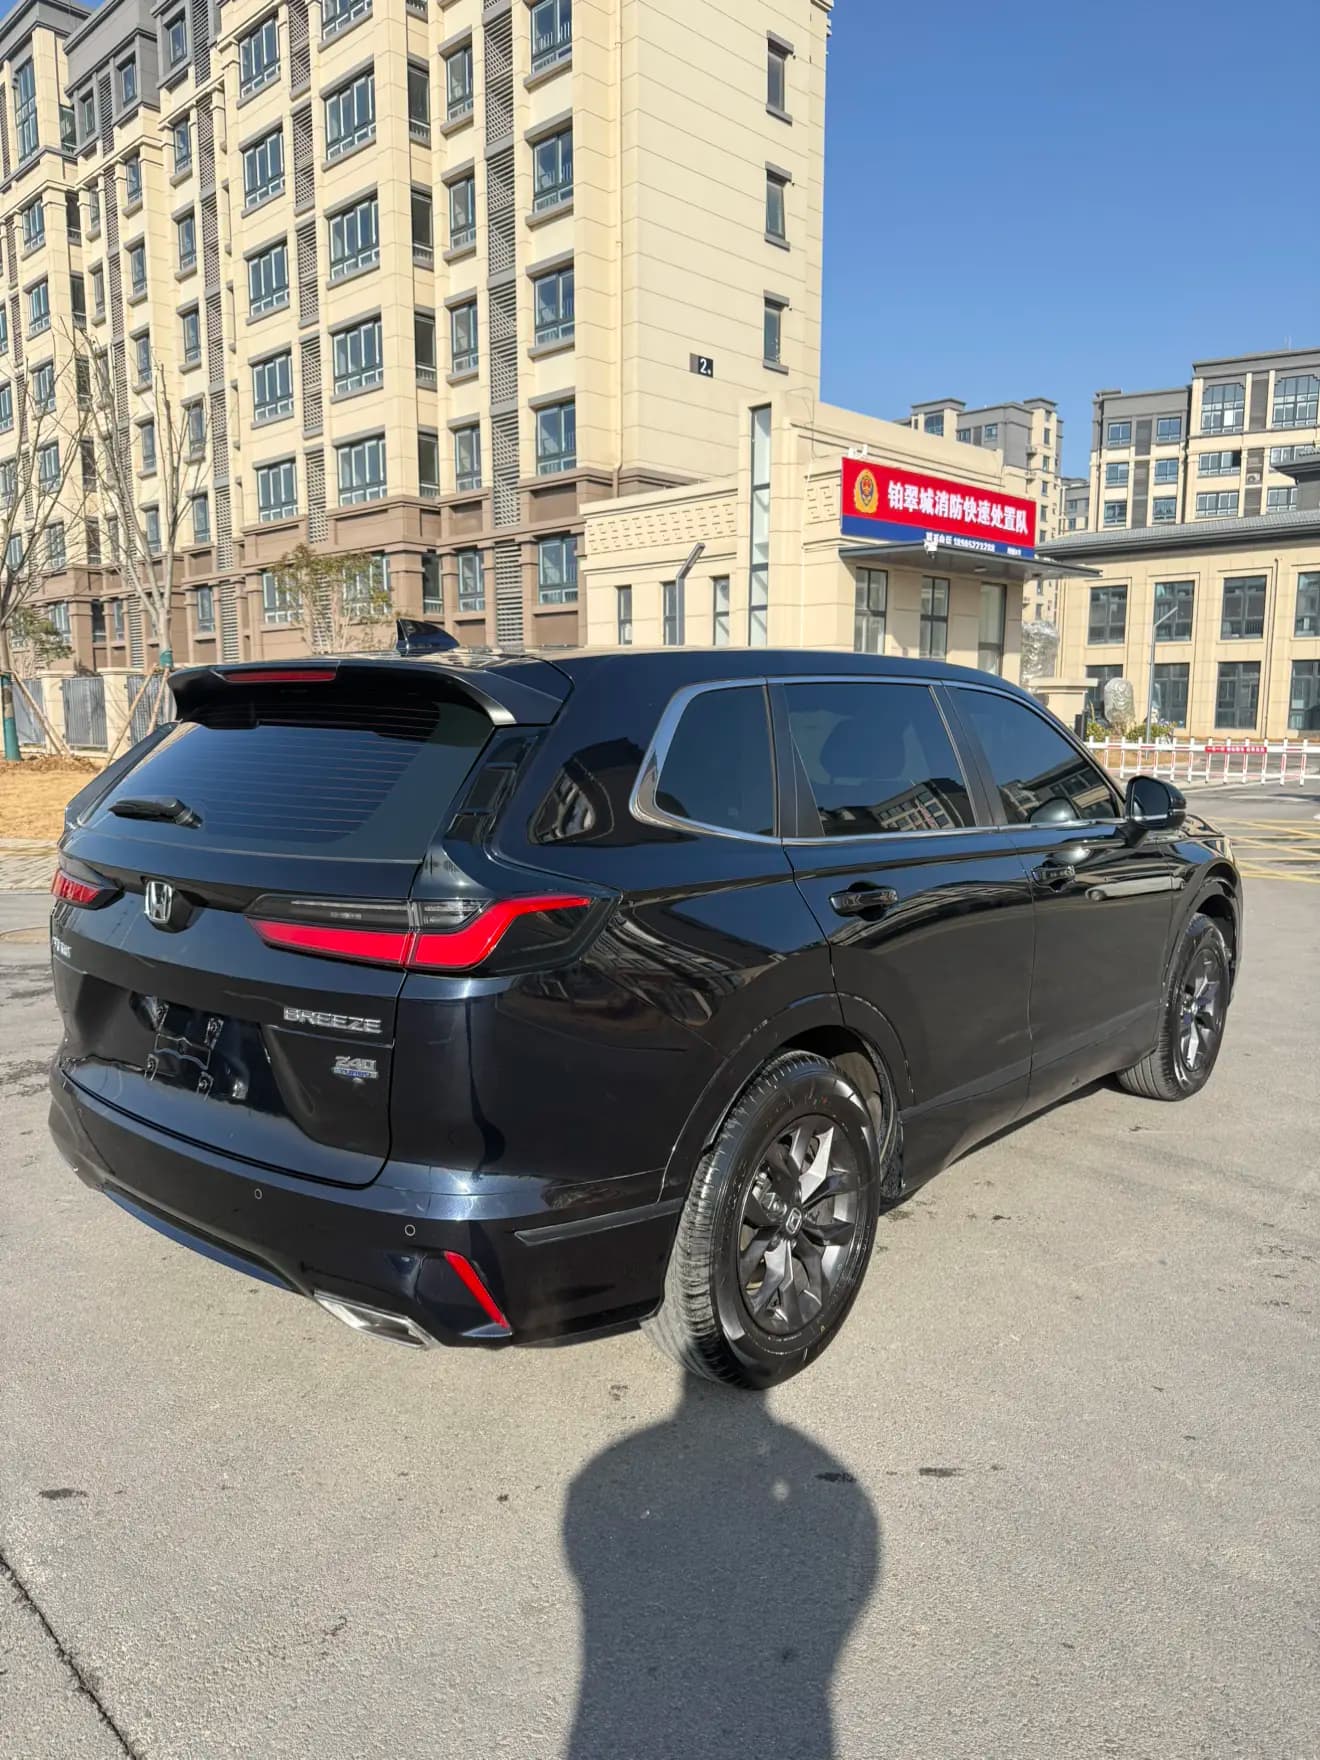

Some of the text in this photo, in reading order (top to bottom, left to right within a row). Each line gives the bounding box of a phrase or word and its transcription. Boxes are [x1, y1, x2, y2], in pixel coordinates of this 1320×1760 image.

[887, 480, 1029, 536] 铂翠城消防快速处置队
[283, 1007, 383, 1034] BREEZE
